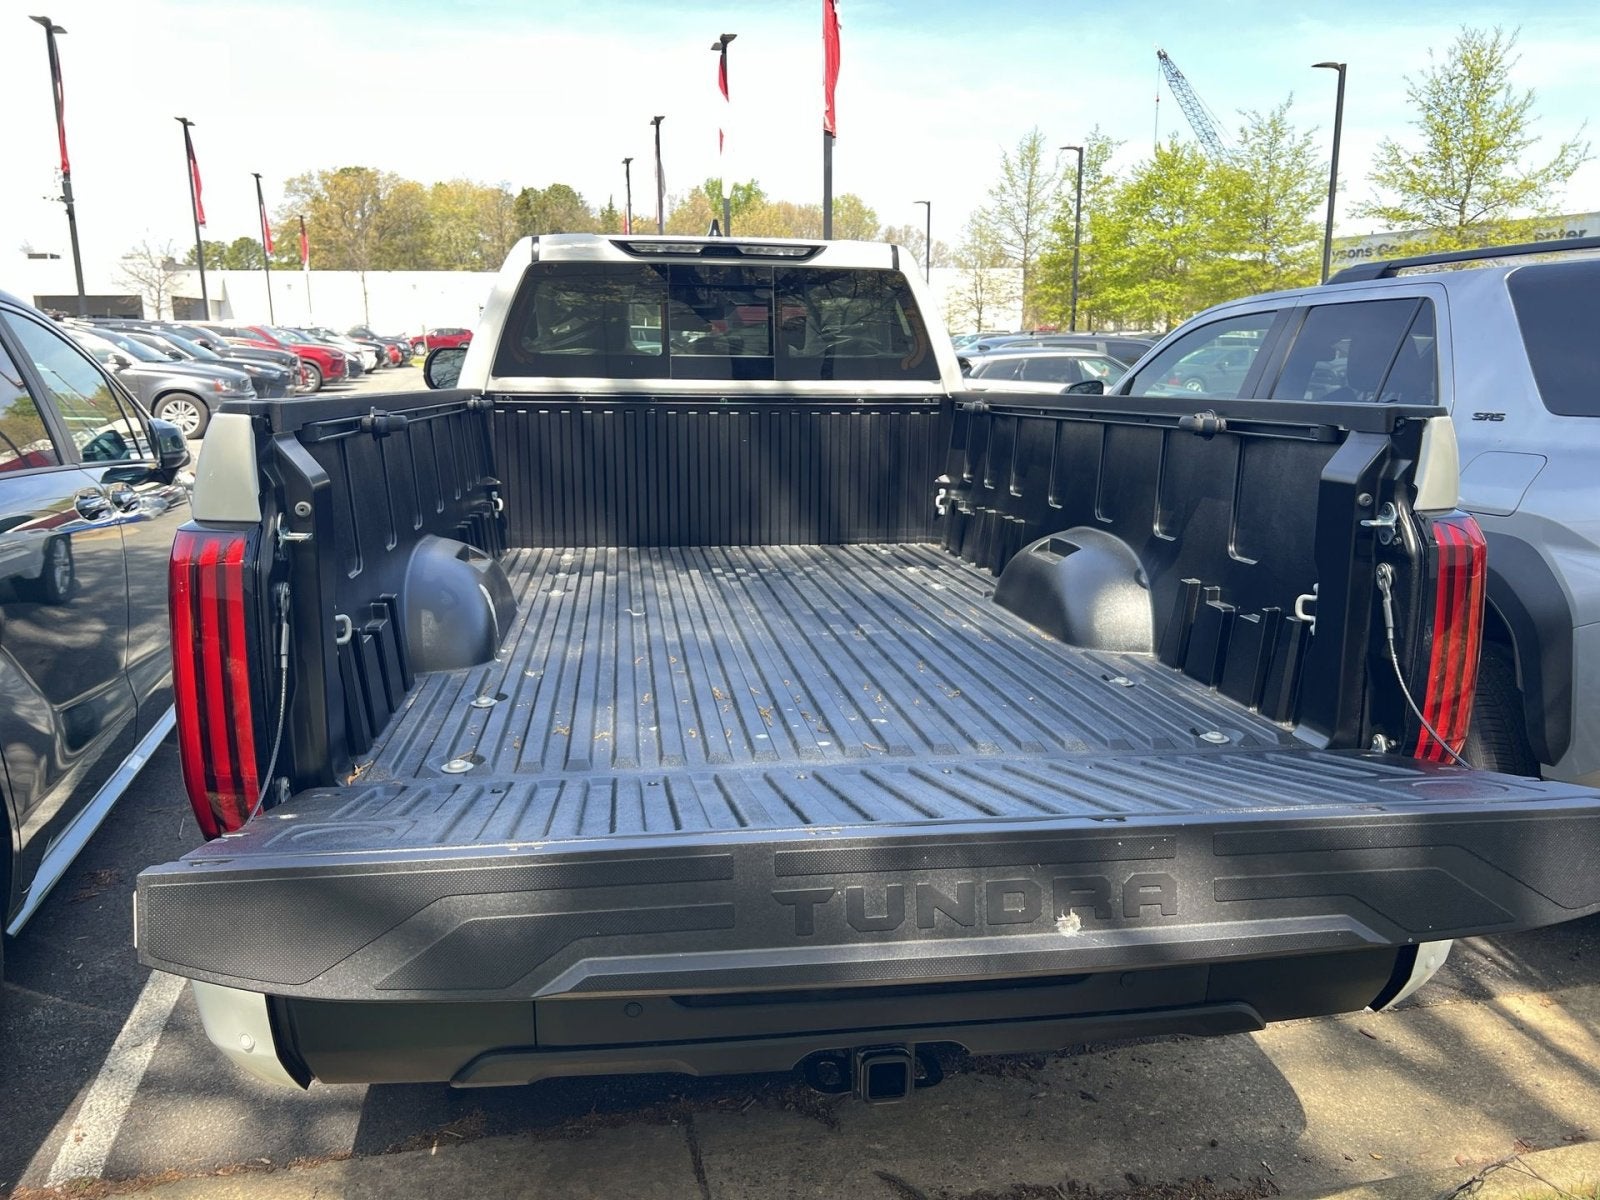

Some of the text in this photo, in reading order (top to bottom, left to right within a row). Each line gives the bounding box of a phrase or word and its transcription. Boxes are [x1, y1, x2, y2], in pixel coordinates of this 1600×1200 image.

[1331, 246, 1373, 263] ysons
[1534, 229, 1588, 241] enter
[771, 872, 1177, 936] TUNDRA
